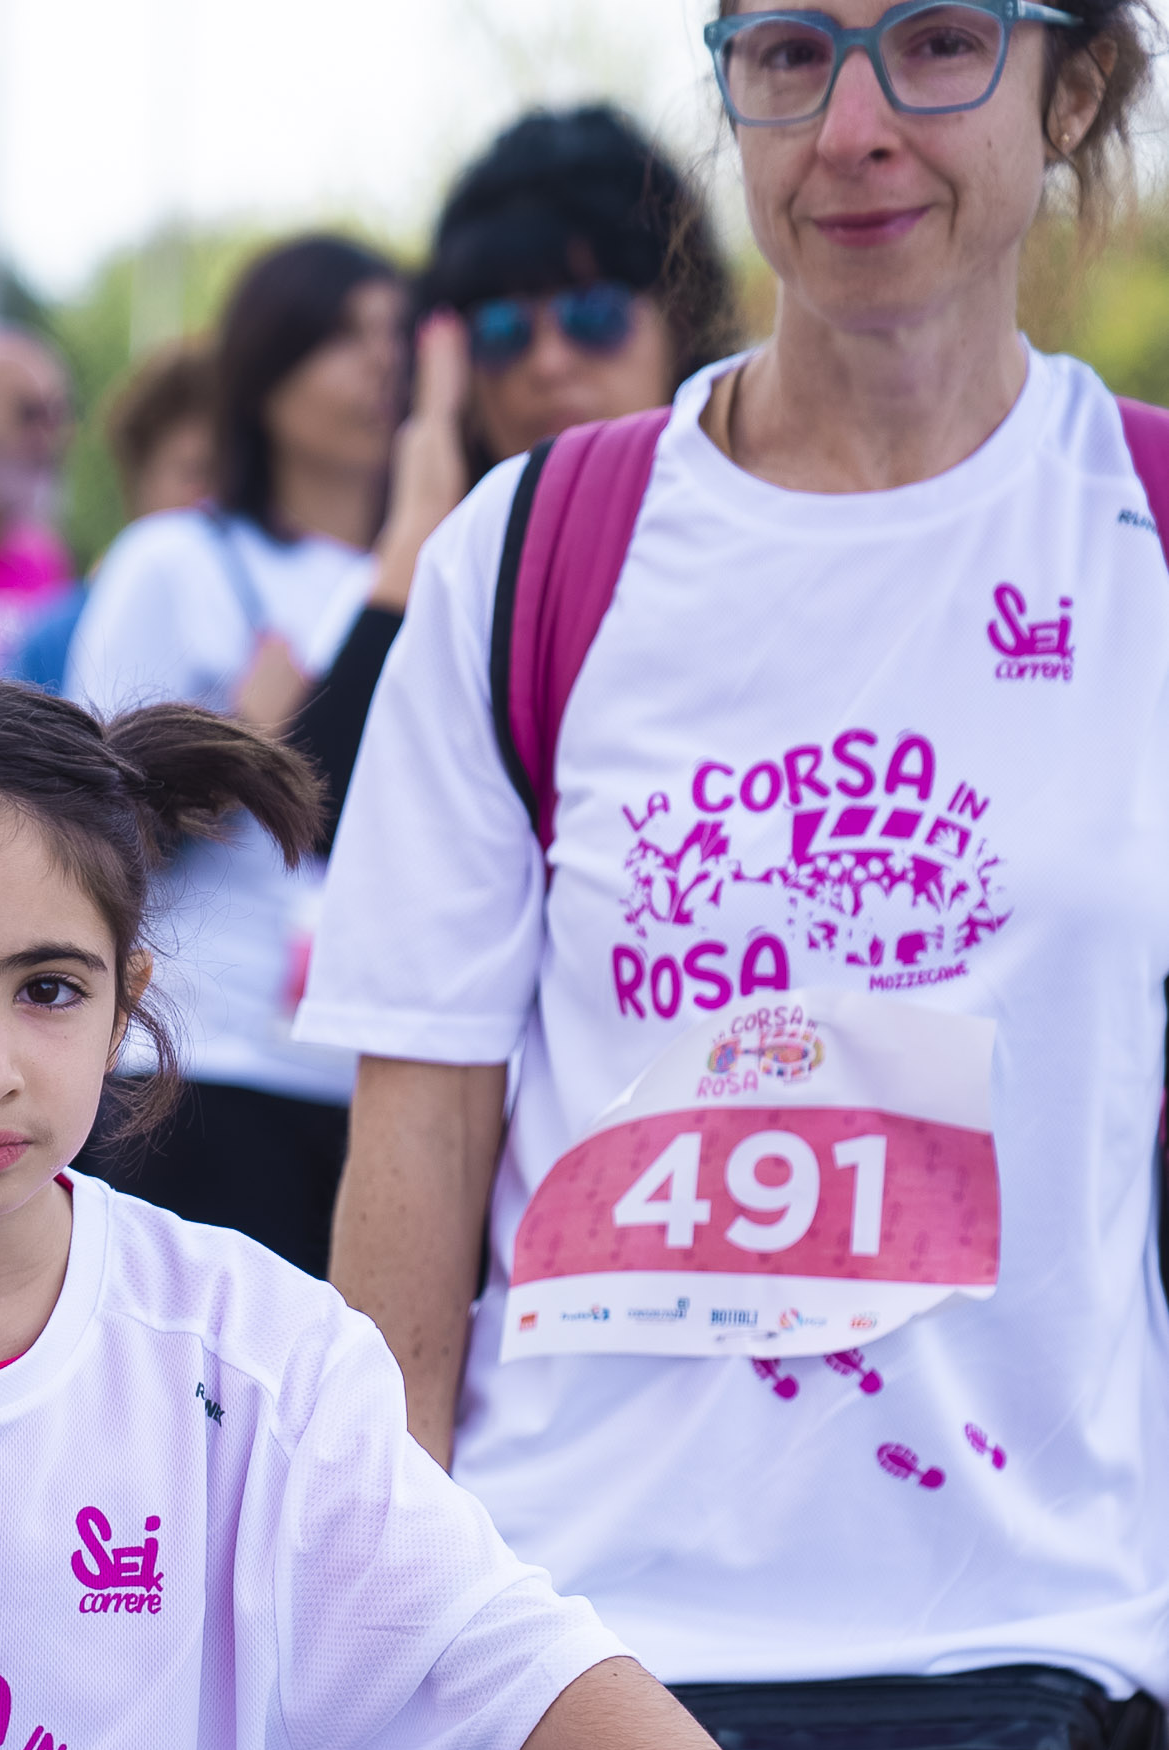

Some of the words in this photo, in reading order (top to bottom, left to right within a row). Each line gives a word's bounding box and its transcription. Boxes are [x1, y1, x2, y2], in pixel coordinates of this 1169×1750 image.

[622, 793, 671, 833] LA
[691, 728, 936, 814] CORSA
[948, 782, 990, 821] IN
[612, 932, 791, 1020] ROSA
[731, 1006, 804, 1034] CORSA
[697, 1070, 759, 1098] ROSA
[613, 1129, 887, 1257] 491
[79, 1592, 162, 1615] correre
